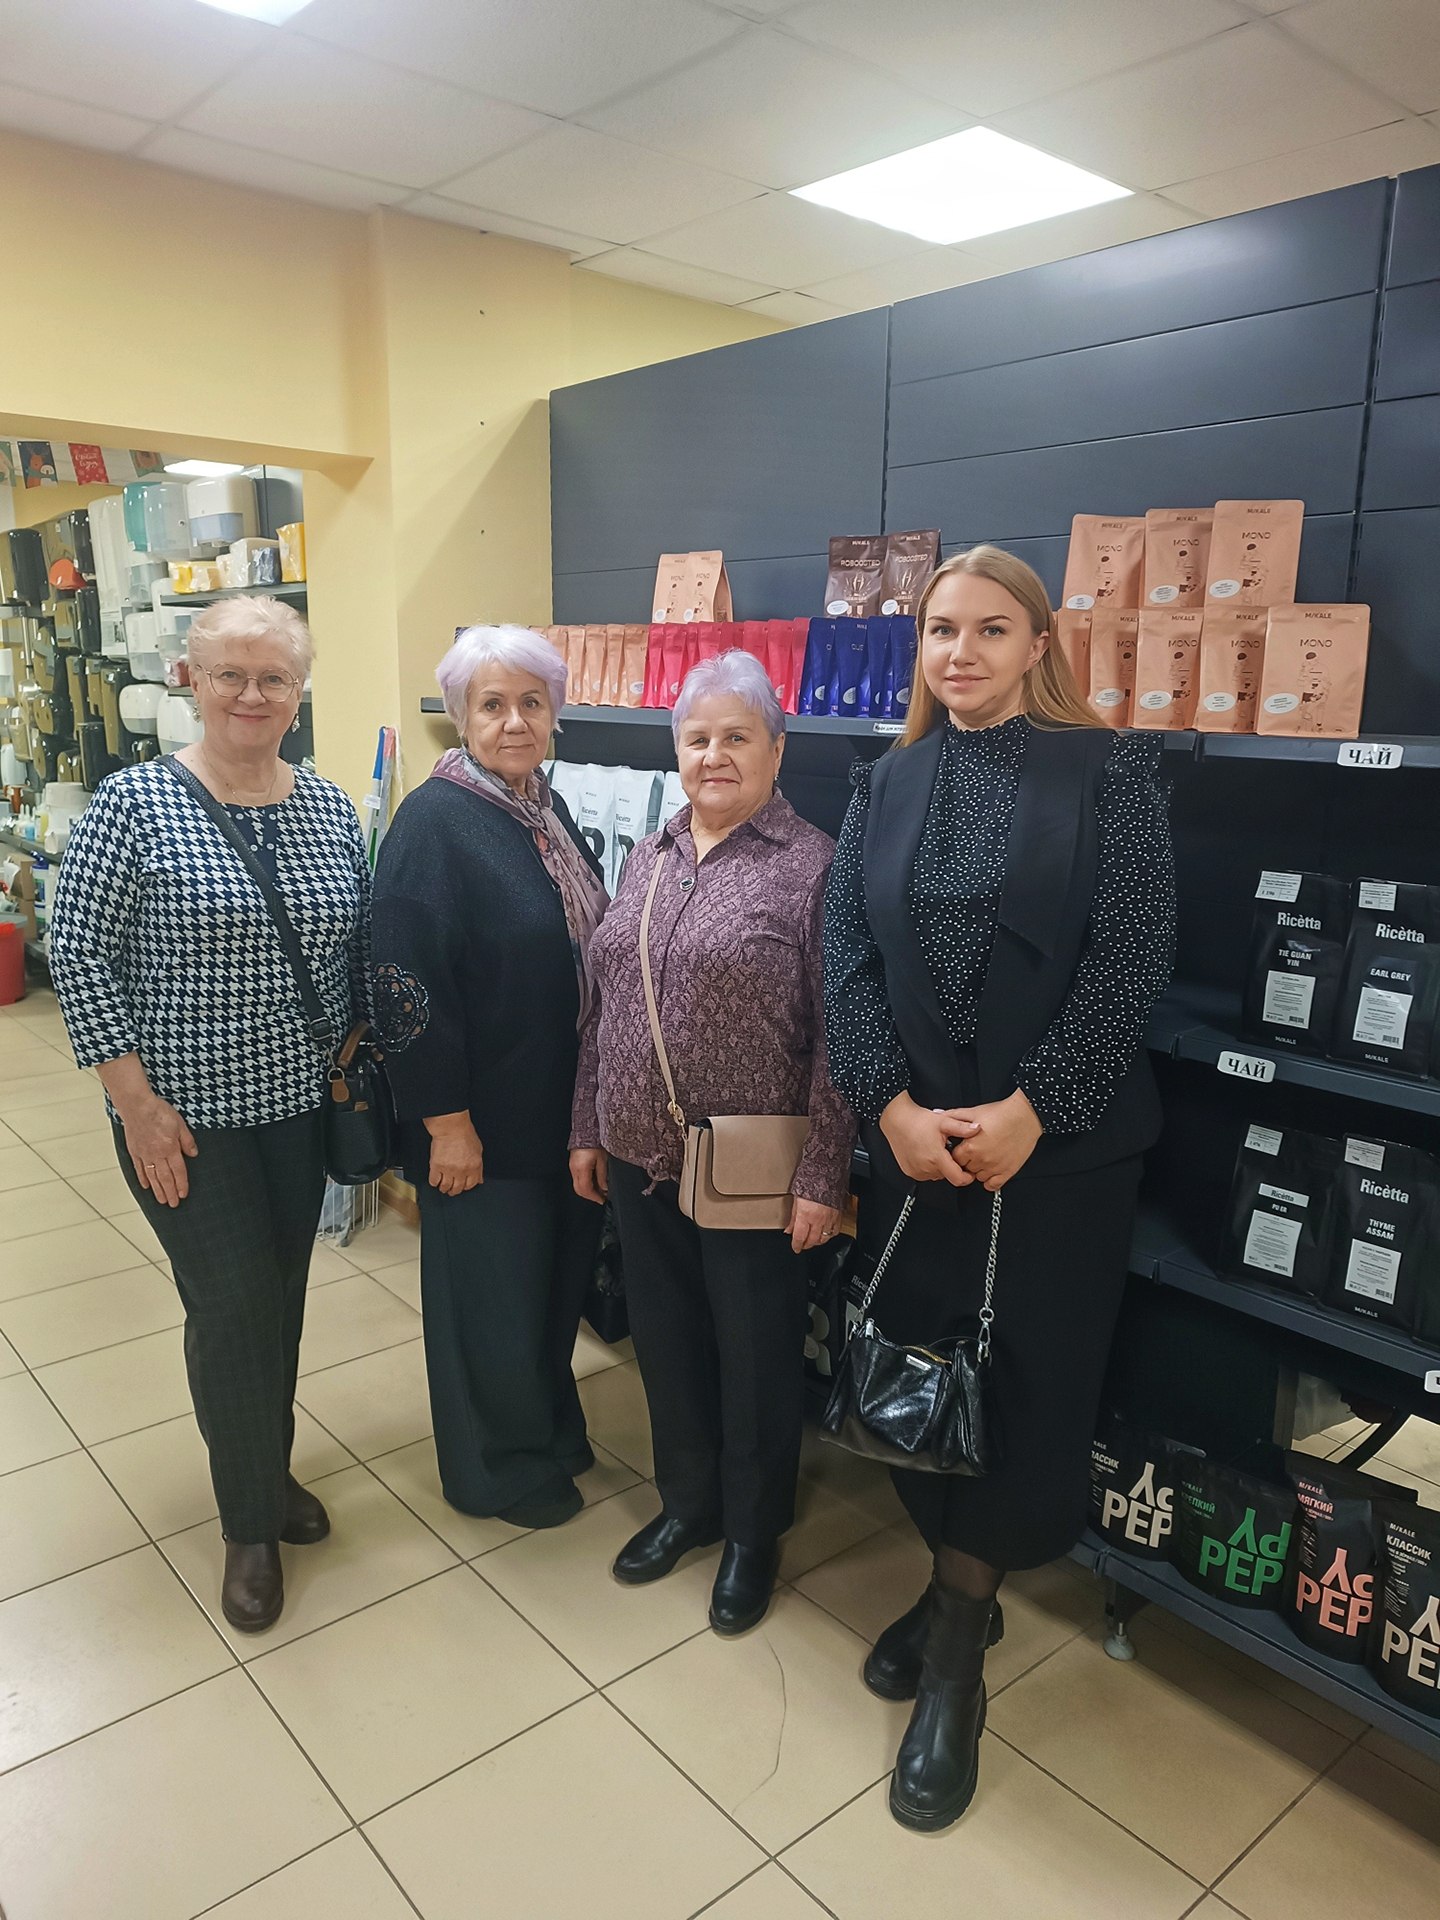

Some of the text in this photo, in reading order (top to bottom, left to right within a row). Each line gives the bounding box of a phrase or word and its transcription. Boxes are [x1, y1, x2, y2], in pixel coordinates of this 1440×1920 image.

[1231, 640, 1260, 648] MONO
[1300, 639, 1332, 648] MONO
[1349, 747, 1392, 766] ЧАЙ
[1277, 912, 1322, 930] Ricètta
[1375, 923, 1425, 943] Ricètta
[1278, 949, 1312, 960] TIE GUAN
[1287, 959, 1300, 967] YIN
[1370, 968, 1412, 981] EARL GREY
[1228, 1058, 1266, 1079] ЧАЙ
[1360, 1178, 1409, 1204] Ricètta
[1366, 1226, 1394, 1240] ASSAM
[1369, 1218, 1396, 1233] THYME
[1297, 1492, 1334, 1514] МЯГКИЙ
[1386, 1534, 1432, 1561] КЛАССИК
